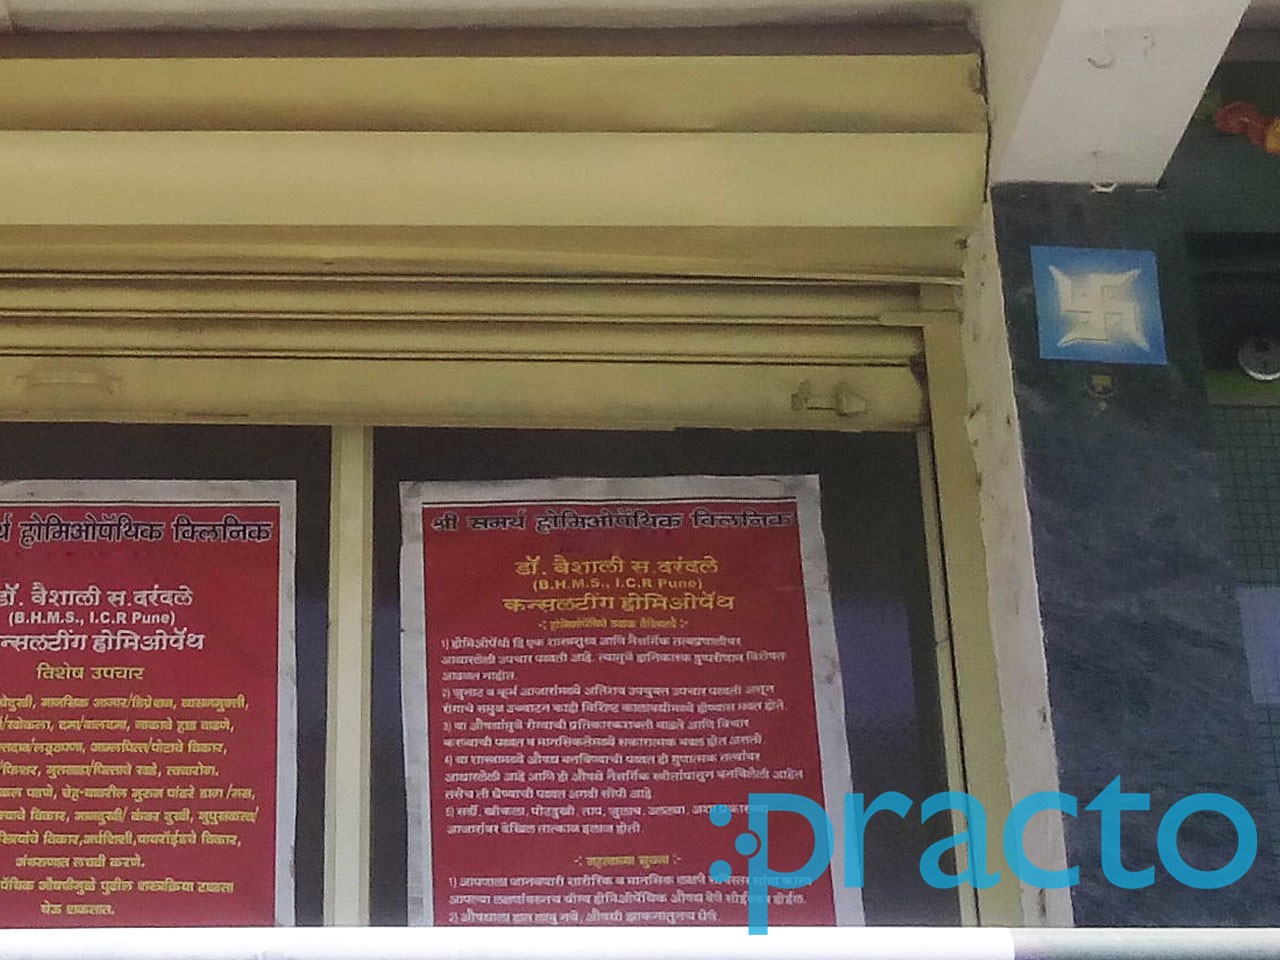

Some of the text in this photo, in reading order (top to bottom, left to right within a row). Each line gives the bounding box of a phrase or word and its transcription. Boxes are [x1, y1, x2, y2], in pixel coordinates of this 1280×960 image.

[431, 511, 459, 532] श्री
[467, 508, 527, 531] समर्थ
[515, 555, 546, 575] डॉ.
[553, 554, 625, 575] वैशाली
[31, 582, 101, 606] वैशाली
[9, 611, 84, 625] (B.H.M.S.,
[132, 611, 175, 625] Pune)
[91, 666, 145, 681] उपचार
